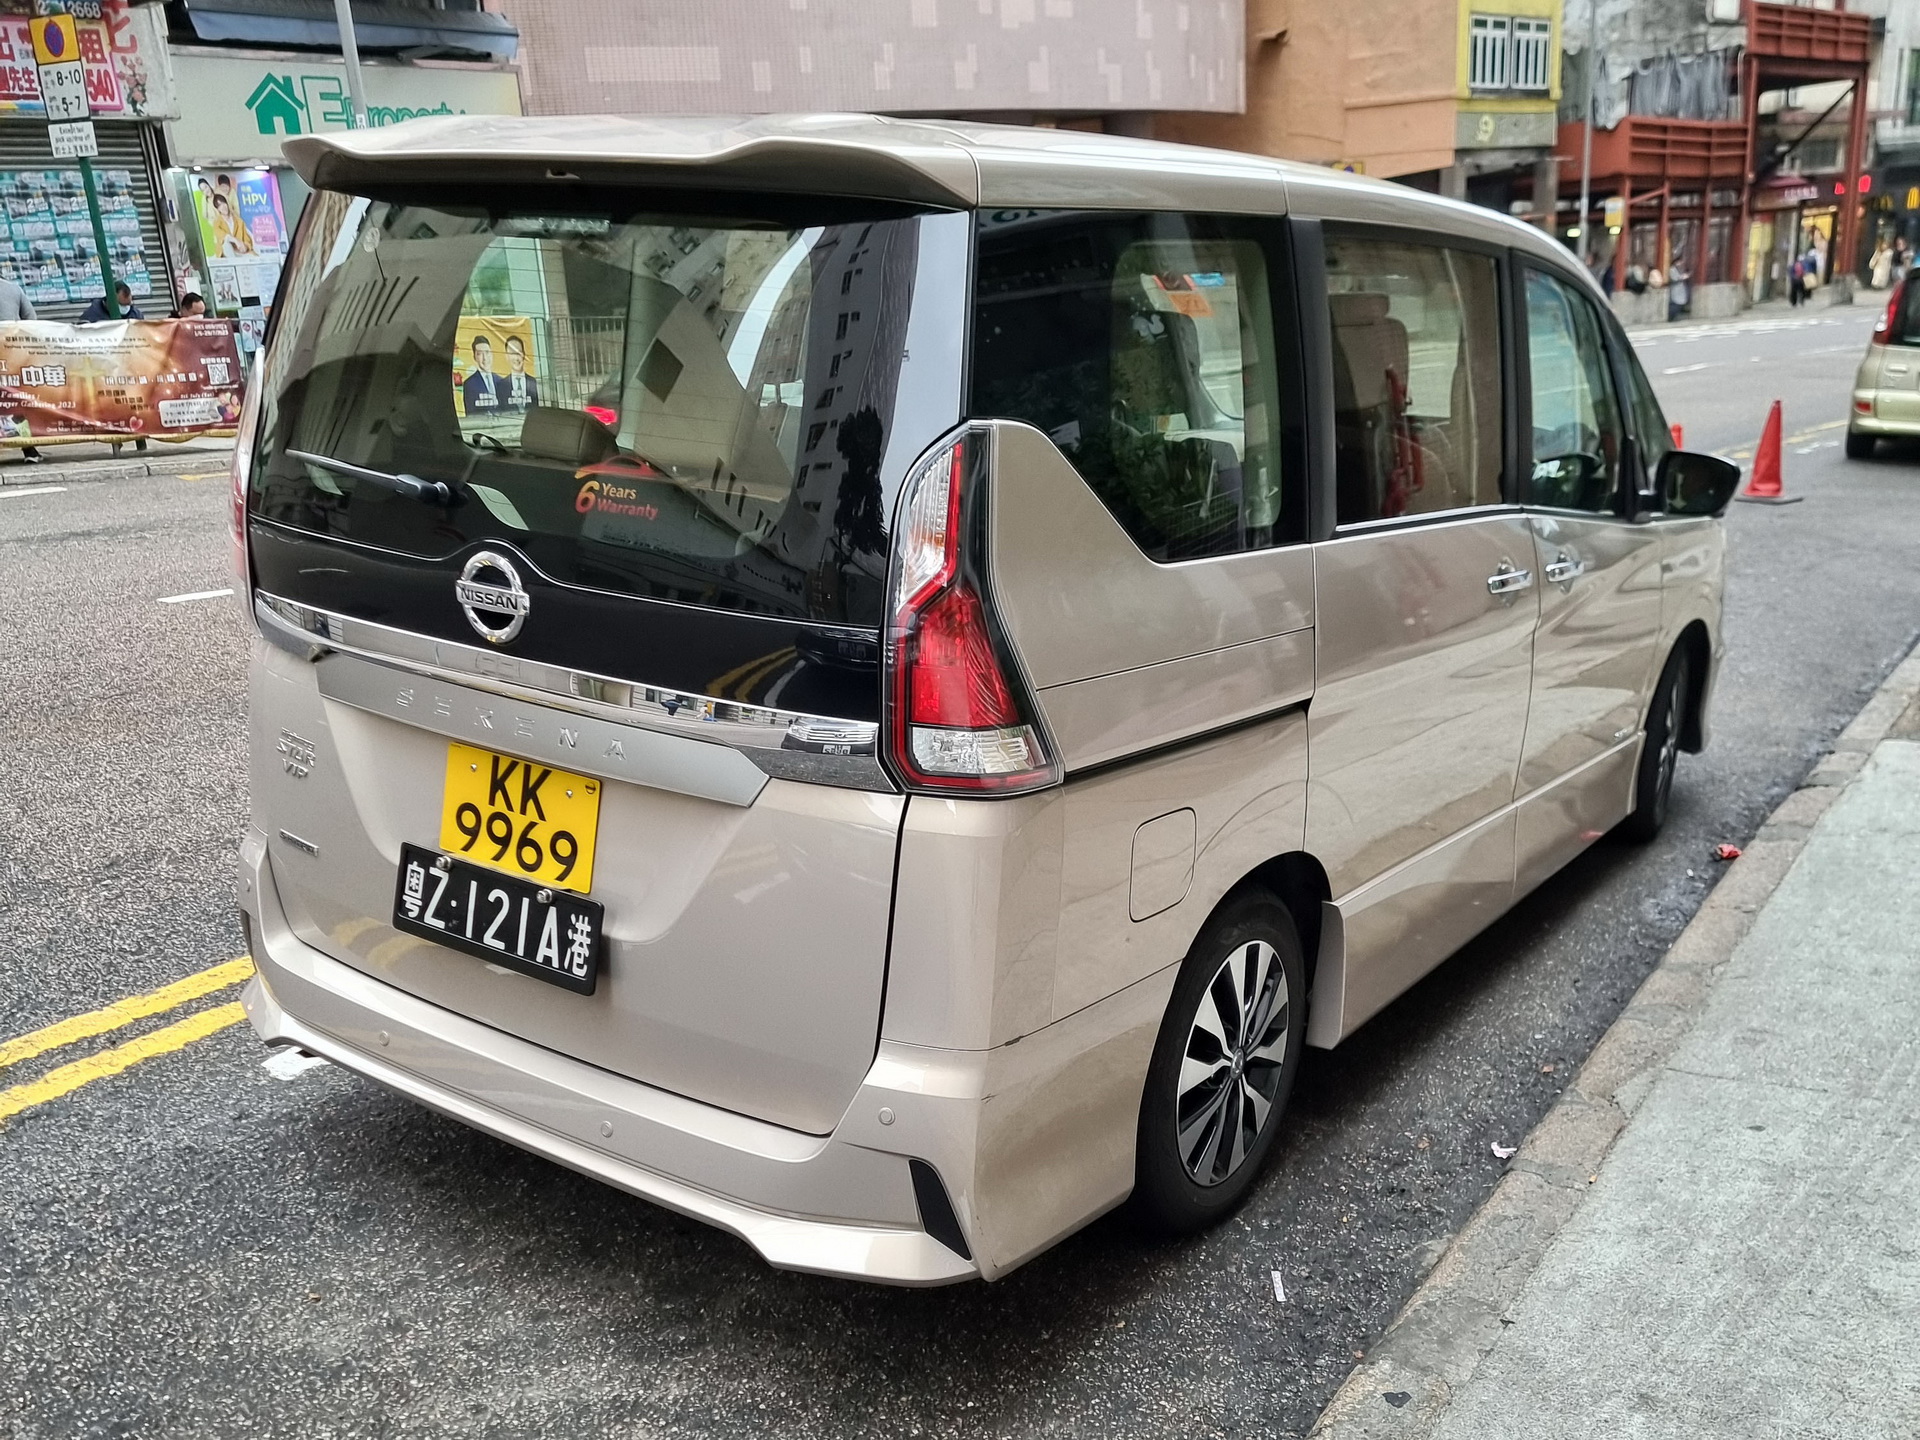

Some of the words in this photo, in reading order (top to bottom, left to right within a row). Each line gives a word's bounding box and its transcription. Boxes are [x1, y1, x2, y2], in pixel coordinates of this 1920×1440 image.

[56, 69, 82, 86] 8-10
[62, 95, 82, 113] 5-7
[241, 192, 267, 206] HPV
[575, 480, 600, 514] 6
[602, 482, 637, 501] Years
[598, 499, 659, 521] Warranty
[460, 586, 520, 611] NISSAN
[396, 687, 627, 762] SERENA
[488, 755, 553, 822] KK
[455, 802, 579, 882] 9969
